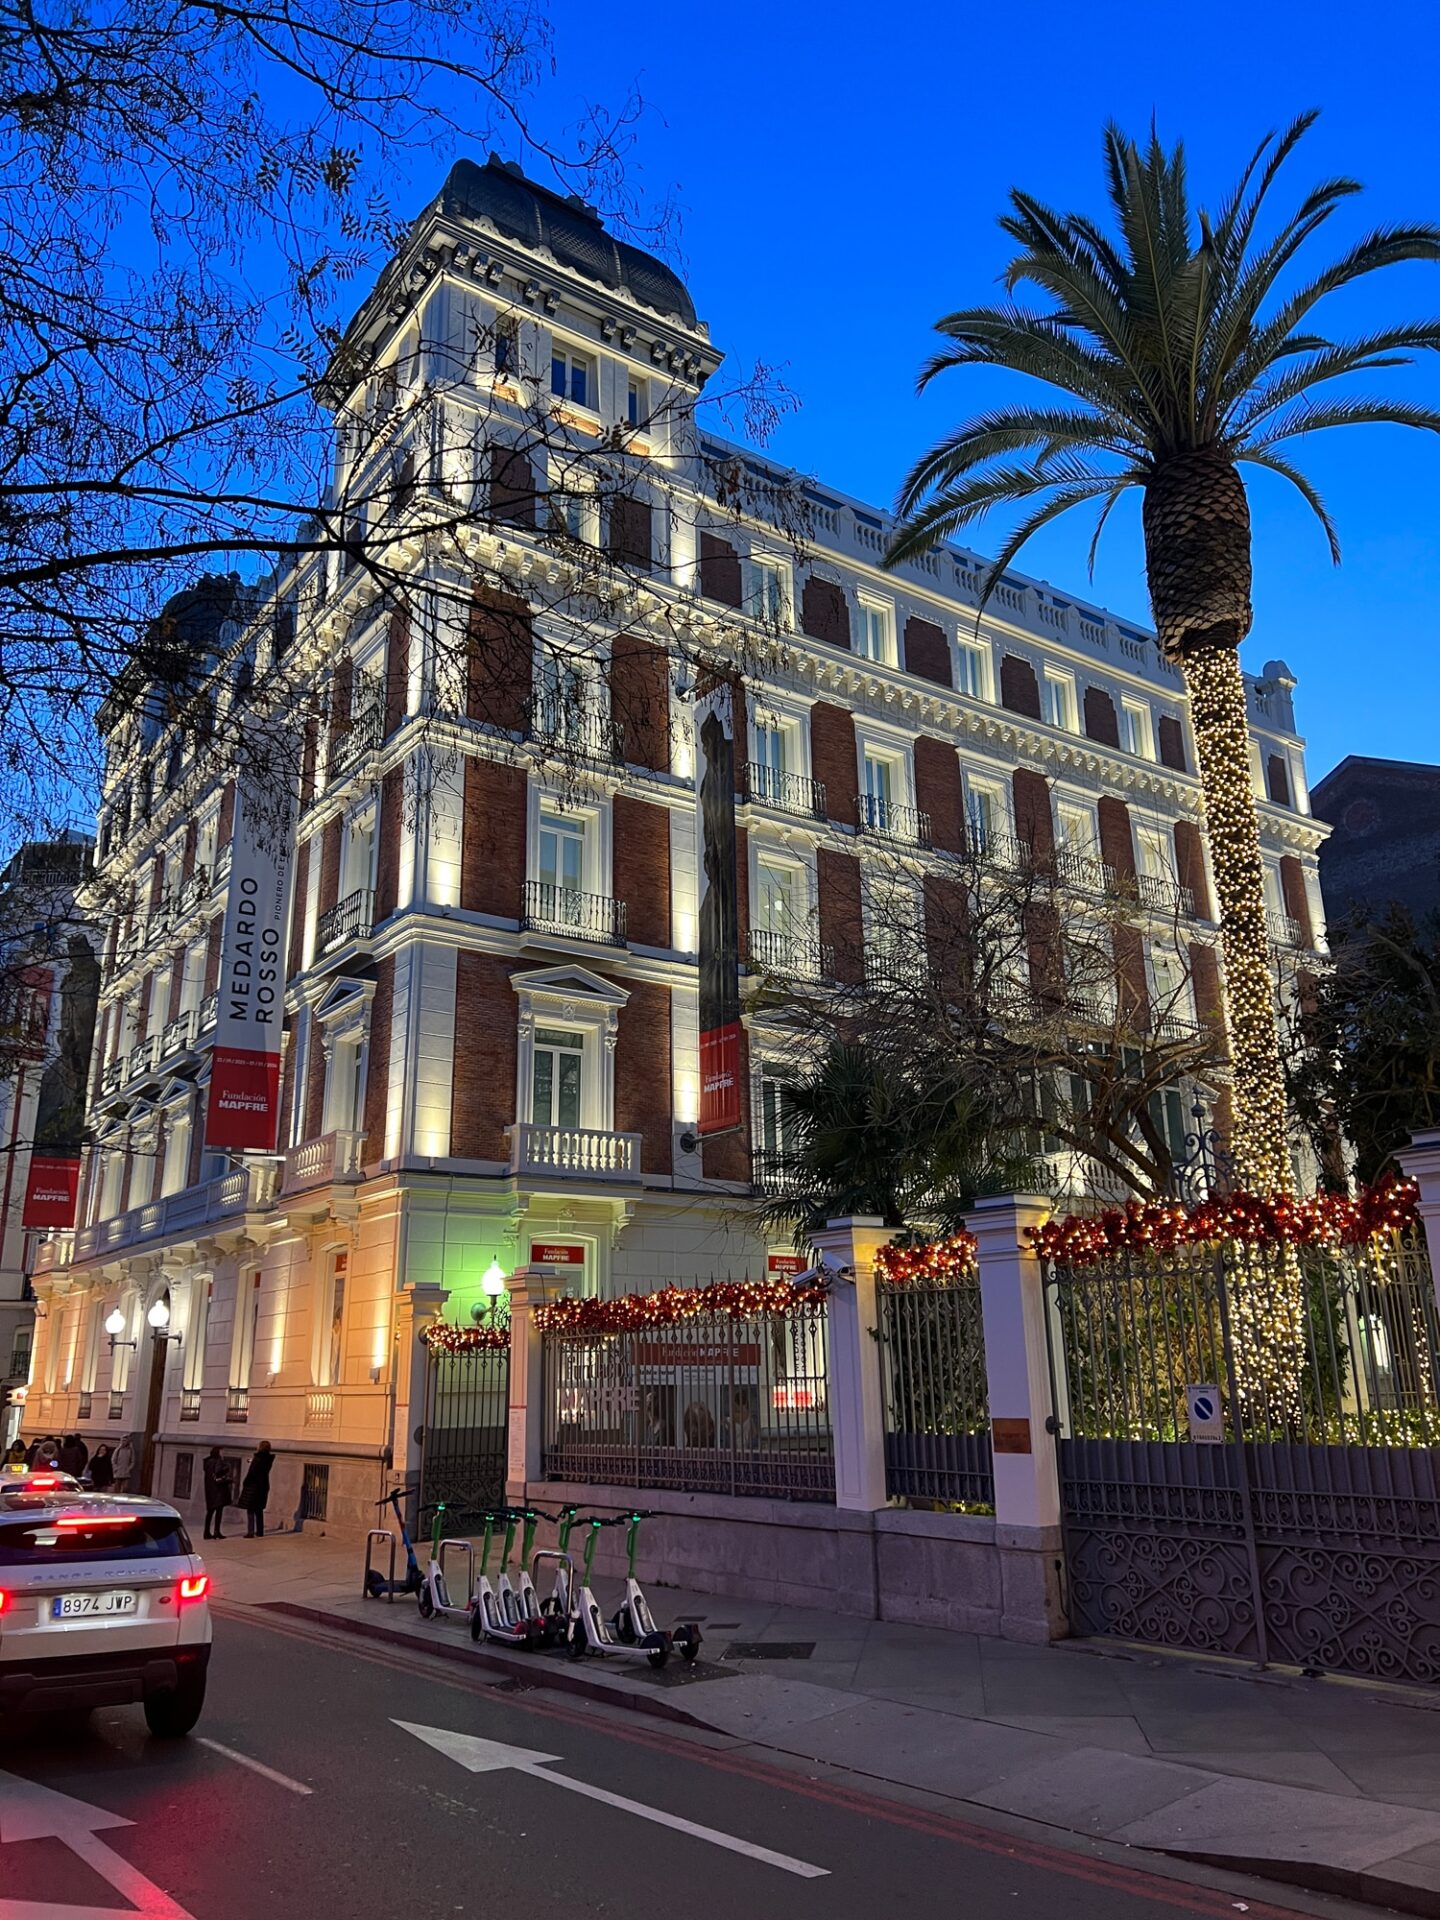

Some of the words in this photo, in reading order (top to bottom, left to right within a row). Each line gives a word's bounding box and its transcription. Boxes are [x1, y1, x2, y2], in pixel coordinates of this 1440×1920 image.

[277, 865, 286, 878] DE
[274, 878, 285, 920] PIONERO
[229, 876, 259, 1022] MEDARDO
[254, 926, 280, 1024] ROSSO
[704, 1077, 733, 1092] MAPFRE
[222, 1090, 266, 1103] Fundación
[218, 1100, 269, 1112] MAPFRE
[32, 1194, 70, 1202] MAPFRE
[560, 1385, 640, 1412] MAPFRE
[63, 1598, 99, 1614] 8974
[106, 1596, 132, 1612] JWP
